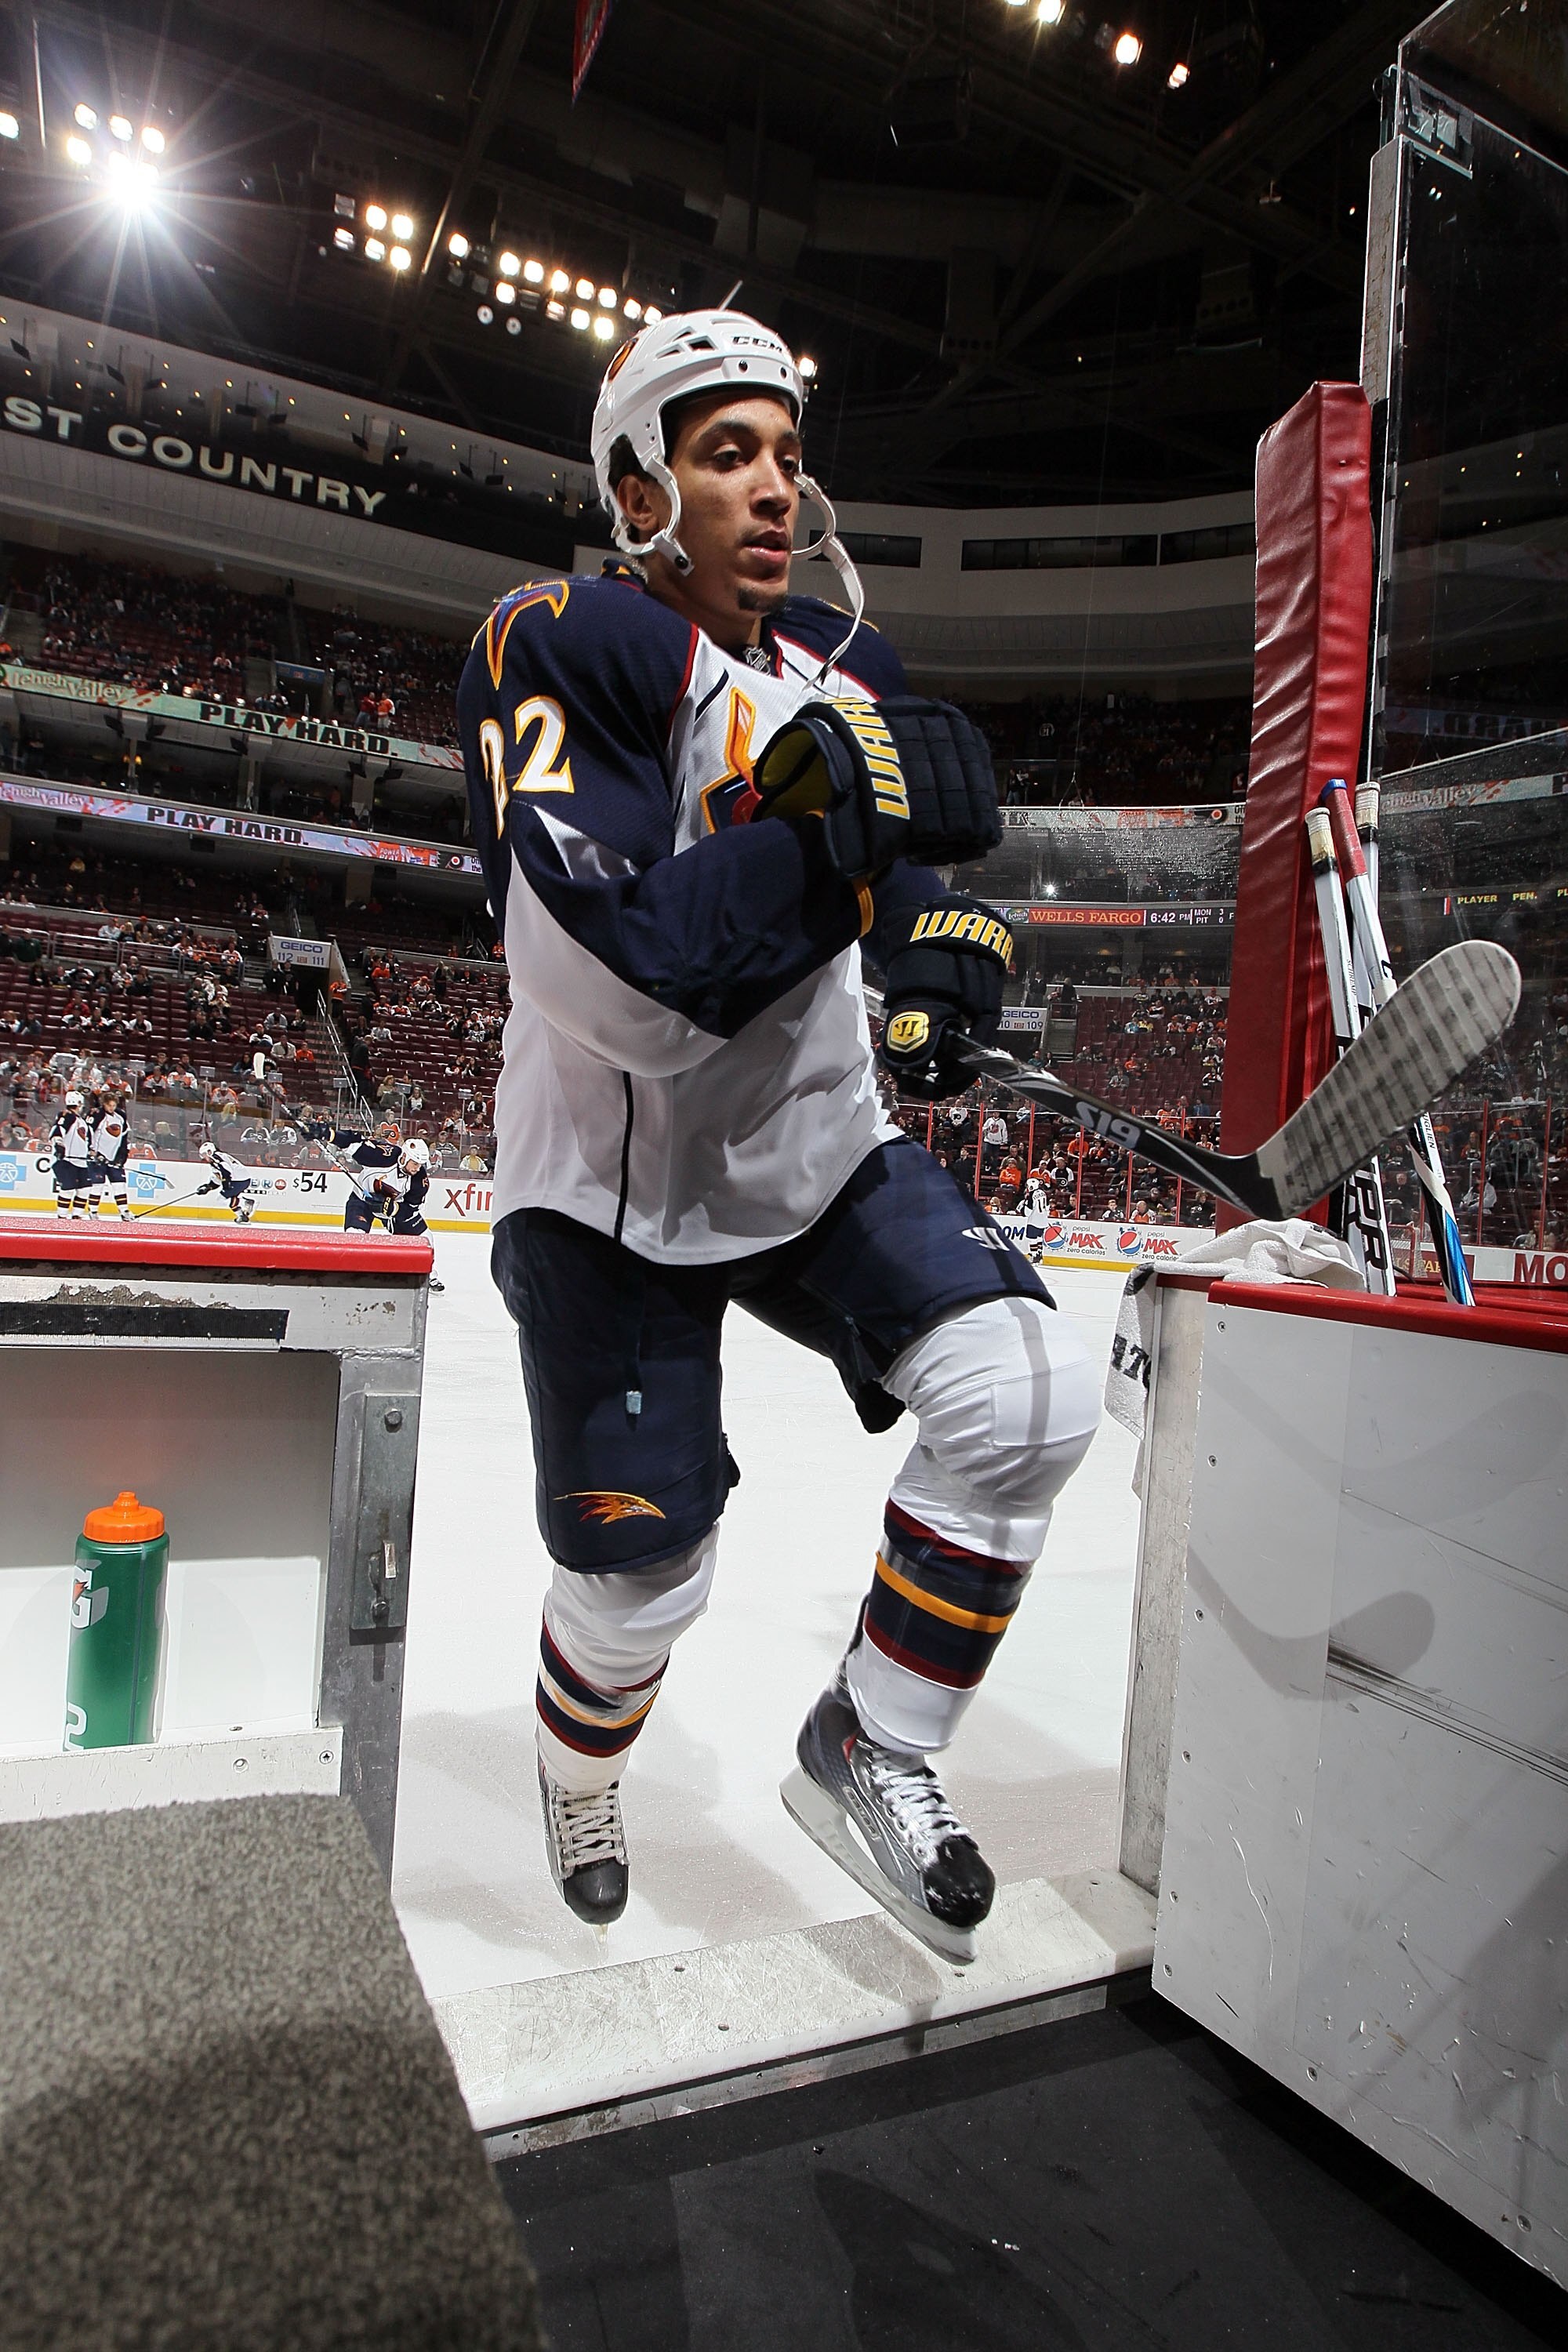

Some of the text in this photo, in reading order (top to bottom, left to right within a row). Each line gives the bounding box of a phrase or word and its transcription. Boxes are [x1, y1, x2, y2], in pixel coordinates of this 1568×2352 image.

[732, 336, 782, 354] CCM
[4, 396, 387, 516] ST COUNTRY
[67, 681, 124, 699] Valley
[200, 702, 397, 757] PLAY HARD.
[41, 793, 85, 806] Valley
[147, 807, 309, 845] PLAY HARD.
[1457, 895, 1497, 904] PLAYER
[1512, 891, 1537, 901] PEN.
[1031, 910, 1142, 924] WELLS FARGO
[1150, 912, 1176, 923] 6:42
[281, 941, 323, 953] GEICO
[278, 952, 294, 962] 112
[312, 956, 325, 965] 111
[1002, 1010, 1040, 1018] GEICO
[1027, 1021, 1044, 1029] 109
[1073, 1102, 1141, 1149] S19
[292, 1171, 328, 1192] $54
[1069, 1233, 1106, 1250] MAX
[1143, 1239, 1181, 1255] MAX
[1081, 1247, 1106, 1256] calories
